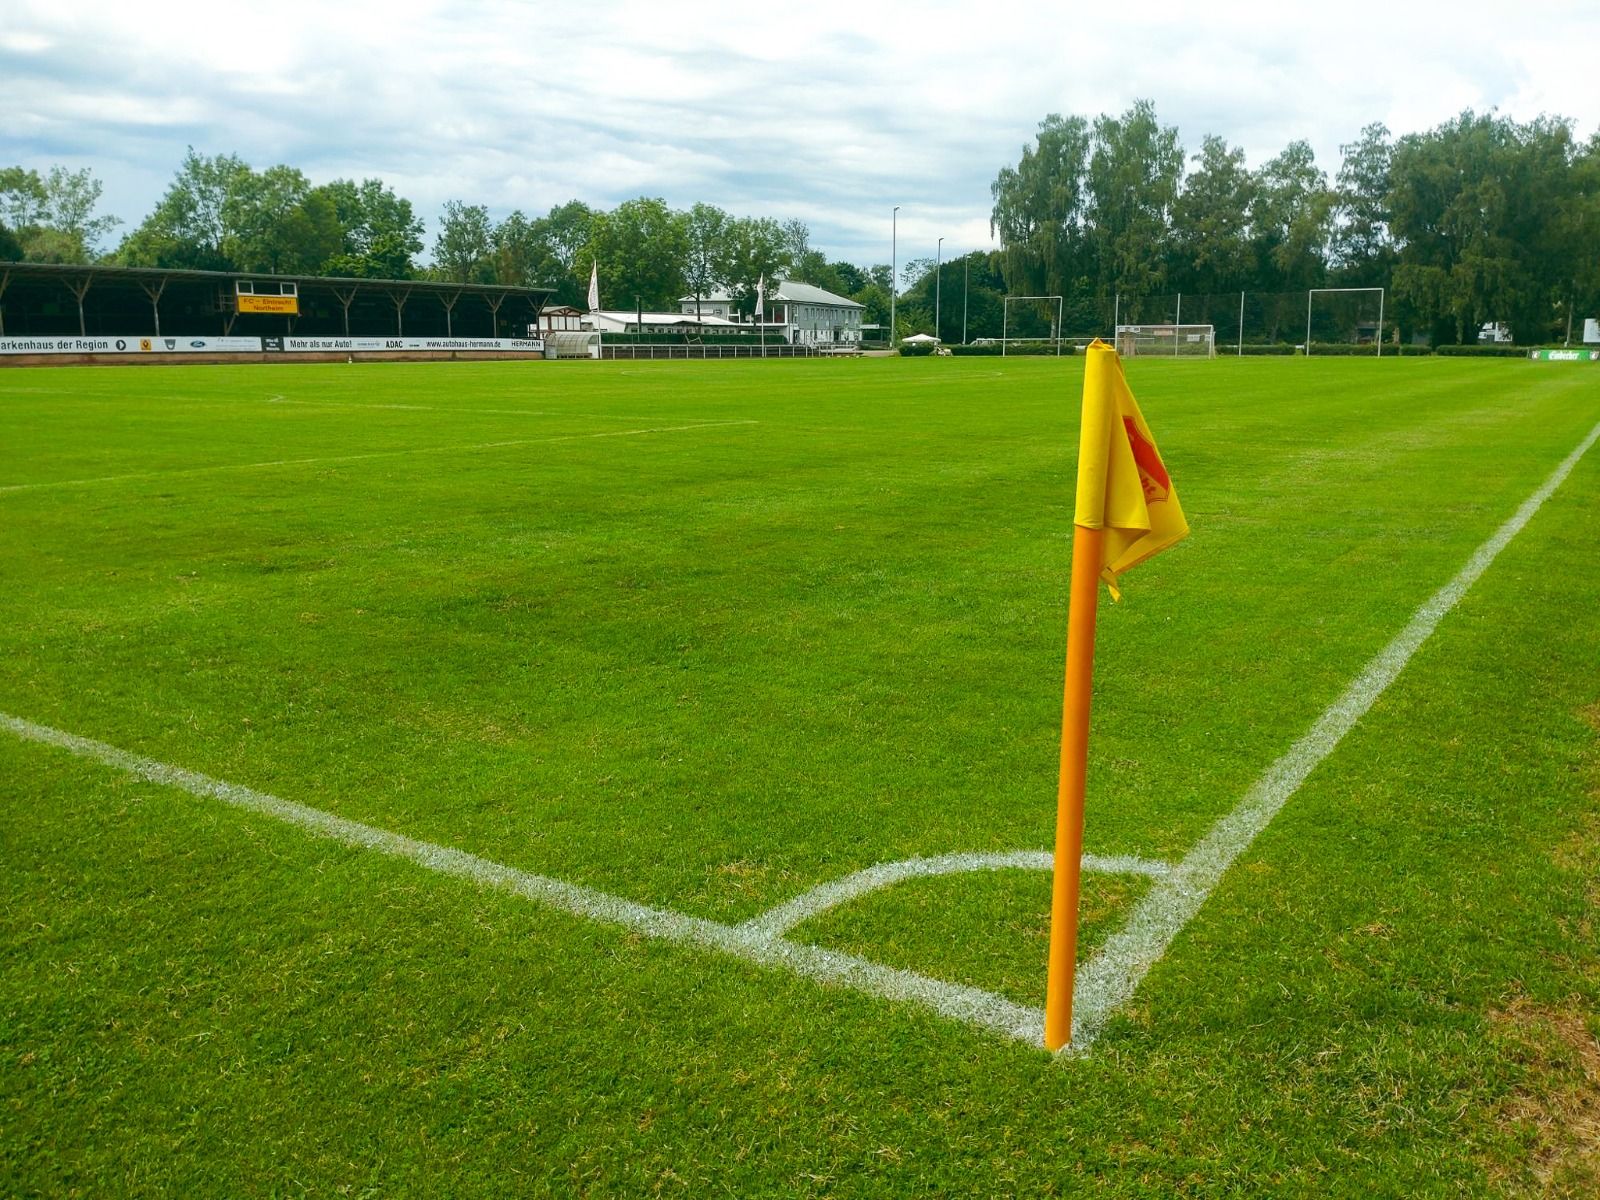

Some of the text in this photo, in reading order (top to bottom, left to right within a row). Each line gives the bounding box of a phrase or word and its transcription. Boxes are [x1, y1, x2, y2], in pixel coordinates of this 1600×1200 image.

[0, 339, 108, 351] arkenhaus der Region
[290, 340, 308, 348] Mehr
[309, 340, 320, 348] als
[334, 340, 352, 348] Auto!
[385, 340, 403, 348] ADAC
[426, 340, 501, 348] www.autohaus-hermann.de
